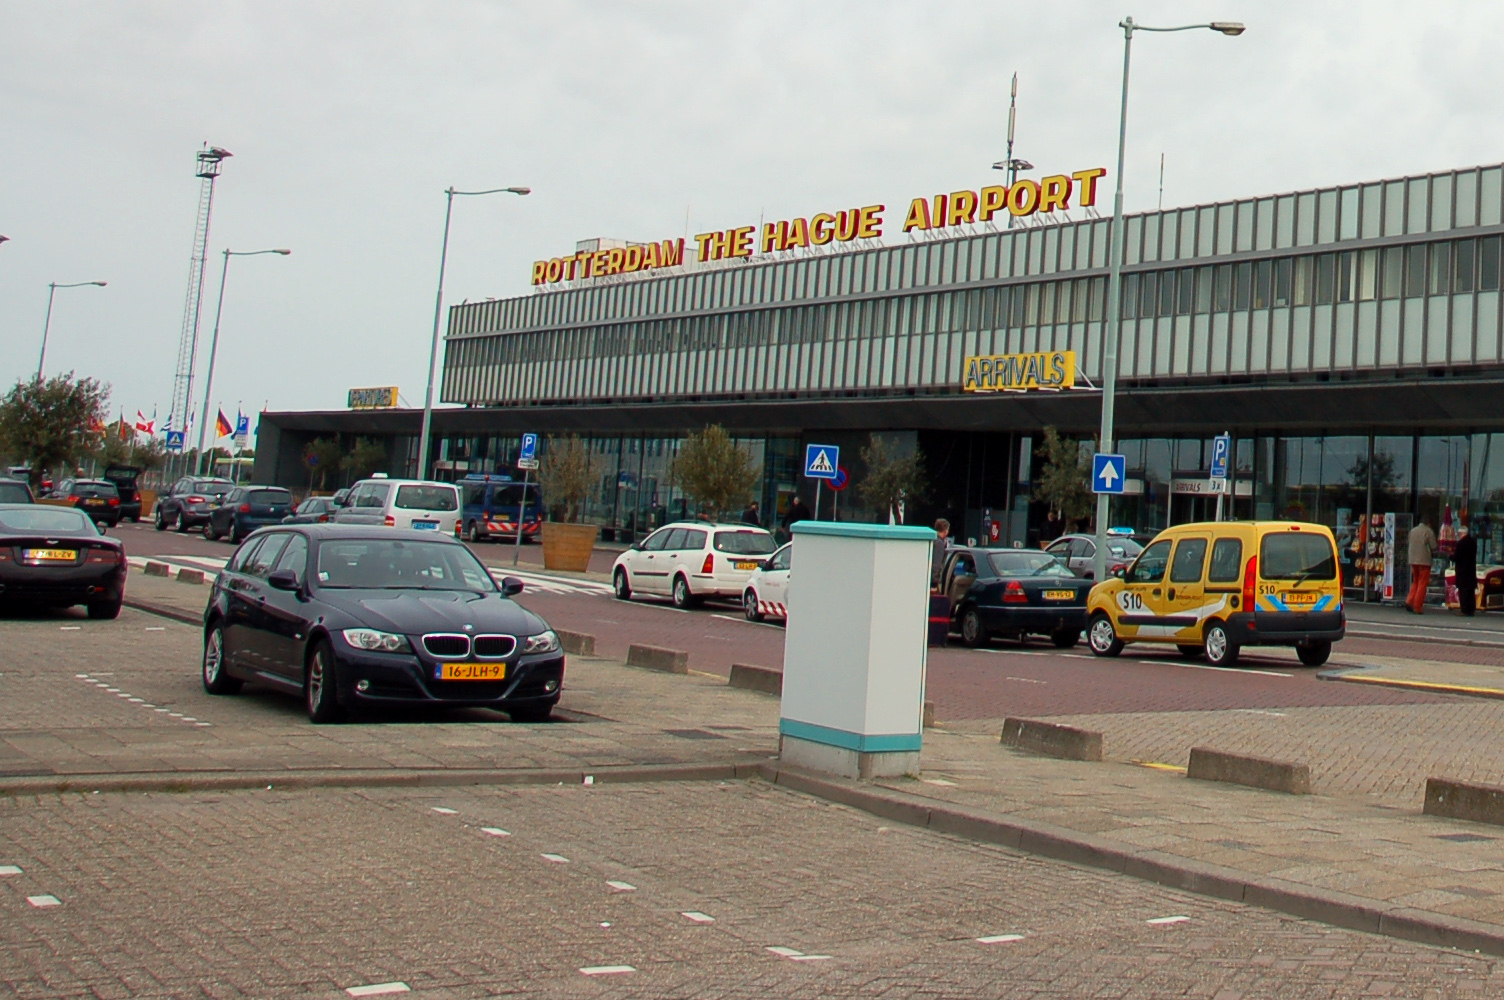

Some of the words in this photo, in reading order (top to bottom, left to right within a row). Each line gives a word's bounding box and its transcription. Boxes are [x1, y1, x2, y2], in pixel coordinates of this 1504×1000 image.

[531, 238, 685, 286] ROTTERDAM
[694, 226, 756, 262] THE
[761, 204, 885, 253] HAGUE
[902, 168, 1106, 233] AIRPORT
[965, 353, 1065, 388] ARRIVALS
[1259, 585, 1275, 595] S10
[1123, 593, 1142, 610] S10
[449, 666, 500, 677] 16-JLH-9
